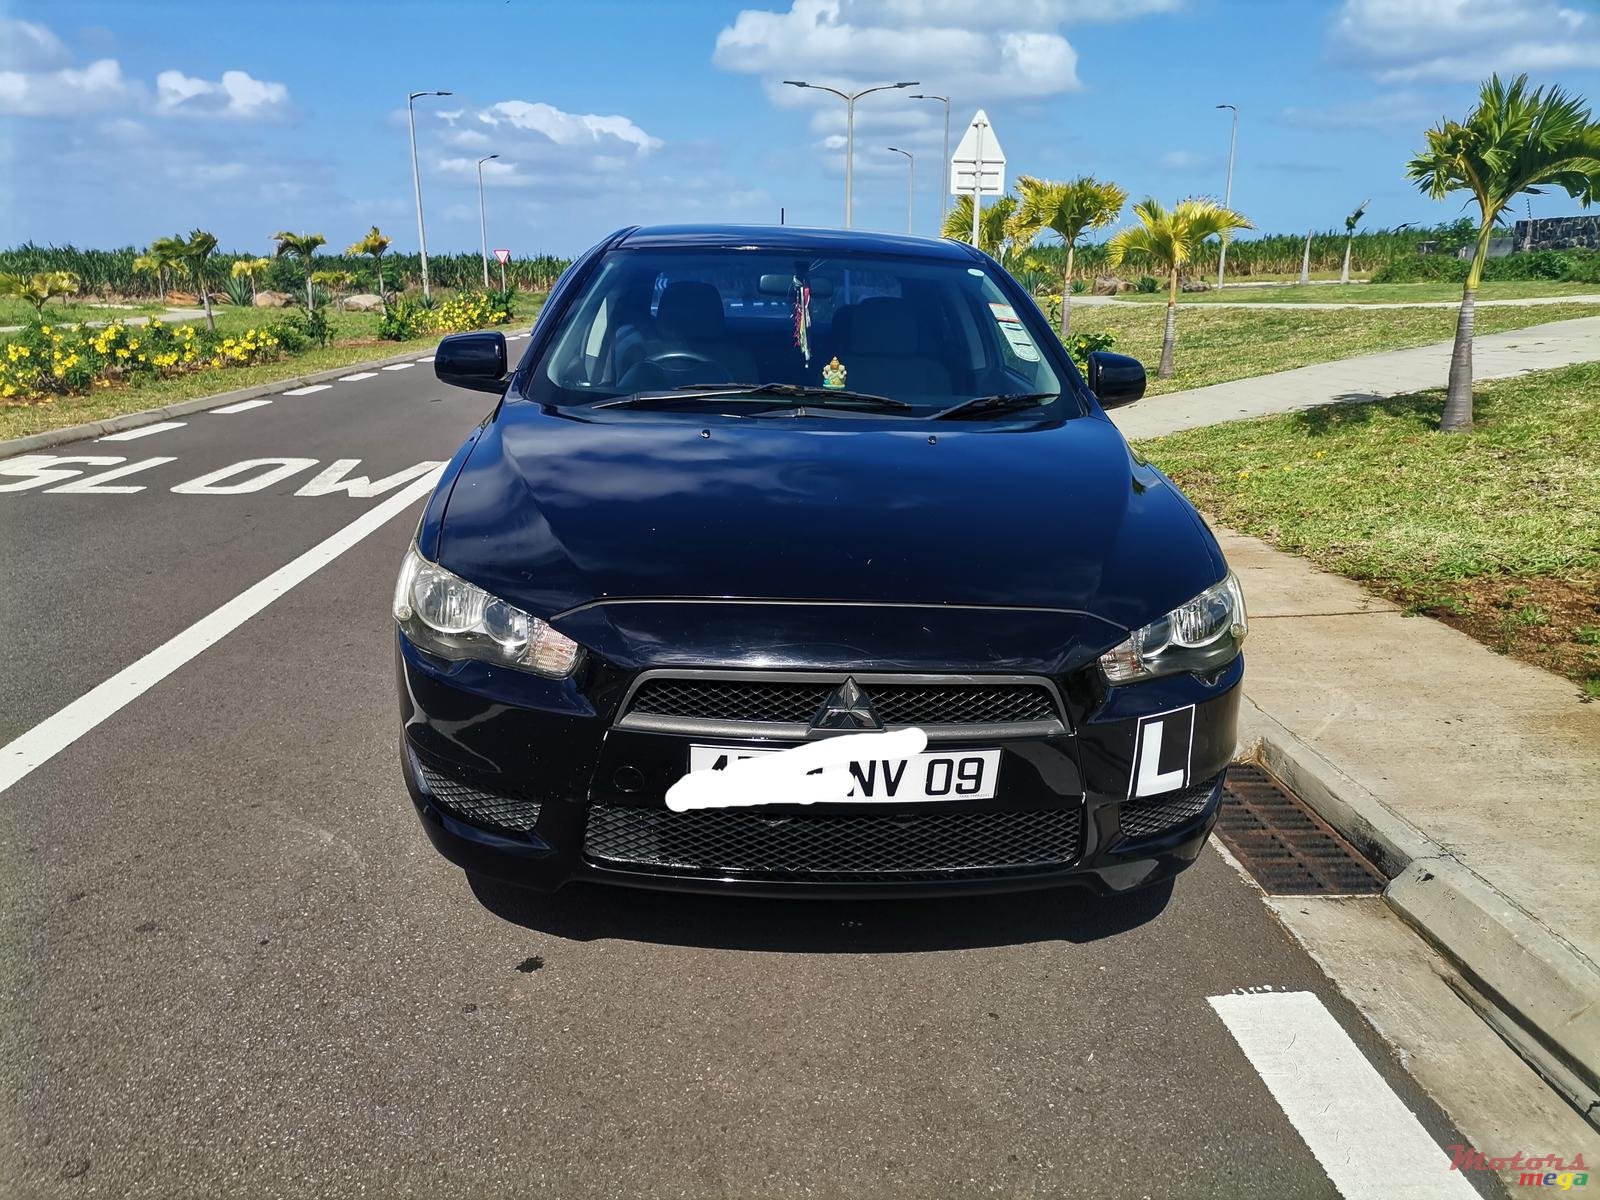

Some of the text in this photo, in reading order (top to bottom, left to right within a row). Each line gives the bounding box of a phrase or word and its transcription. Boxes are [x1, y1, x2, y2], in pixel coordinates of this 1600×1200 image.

[0, 455, 448, 498] SLOW
[847, 760, 908, 797] NV
[925, 757, 985, 796] 09
[1136, 721, 1184, 797] L
